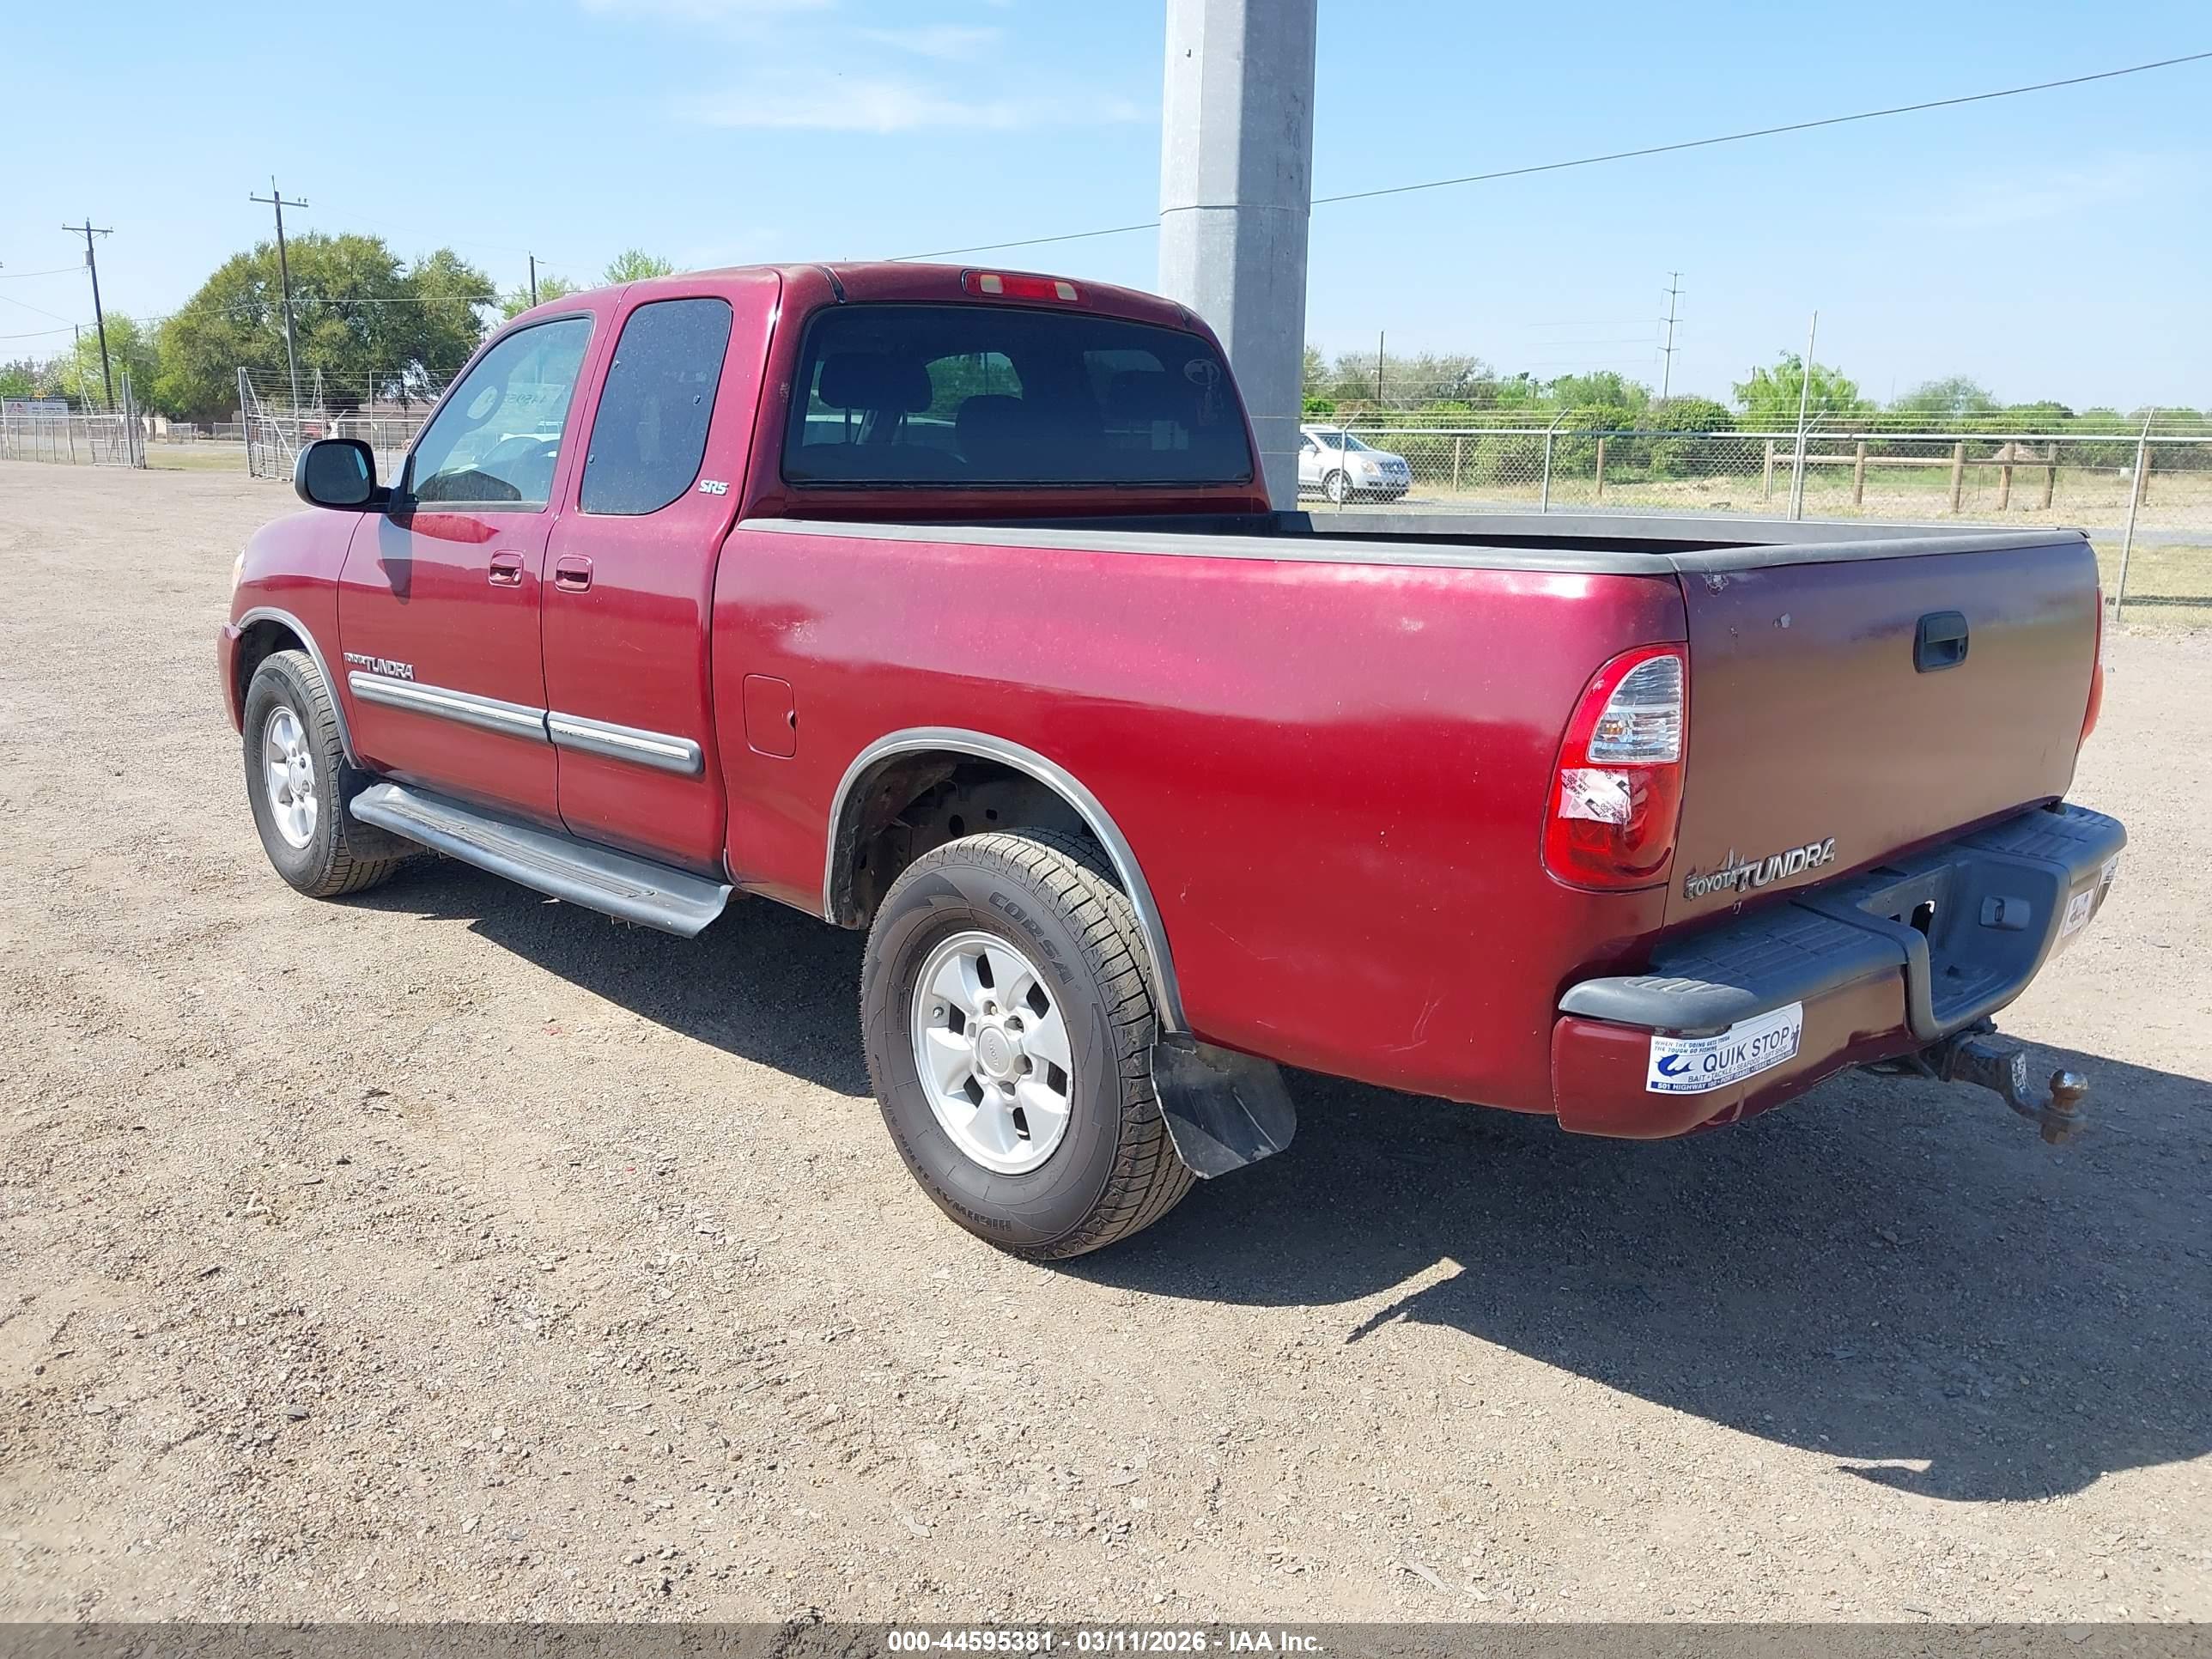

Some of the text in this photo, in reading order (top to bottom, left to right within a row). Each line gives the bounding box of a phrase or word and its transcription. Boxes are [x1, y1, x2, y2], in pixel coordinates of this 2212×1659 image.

[698, 479, 730, 495] SR5
[364, 655, 414, 680] TUNDRA
[1687, 837, 1834, 899] TOYOTA TUNDRA
[989, 892, 1074, 985] CORSA
[1688, 1074, 1705, 1083] BAIT
[1711, 1066, 1733, 1079] TACKLE
[1736, 1056, 1761, 1071] SEAFOOD
[1763, 1051, 1775, 1060] GIFT
[1703, 1043, 1747, 1073] QUIK
[1751, 1026, 1790, 1057] STOP
[1672, 1082, 1706, 1091] HIGHWAY
[1720, 1075, 1734, 1084] PORT
[934, 1185, 1012, 1232] HIGHWAY
